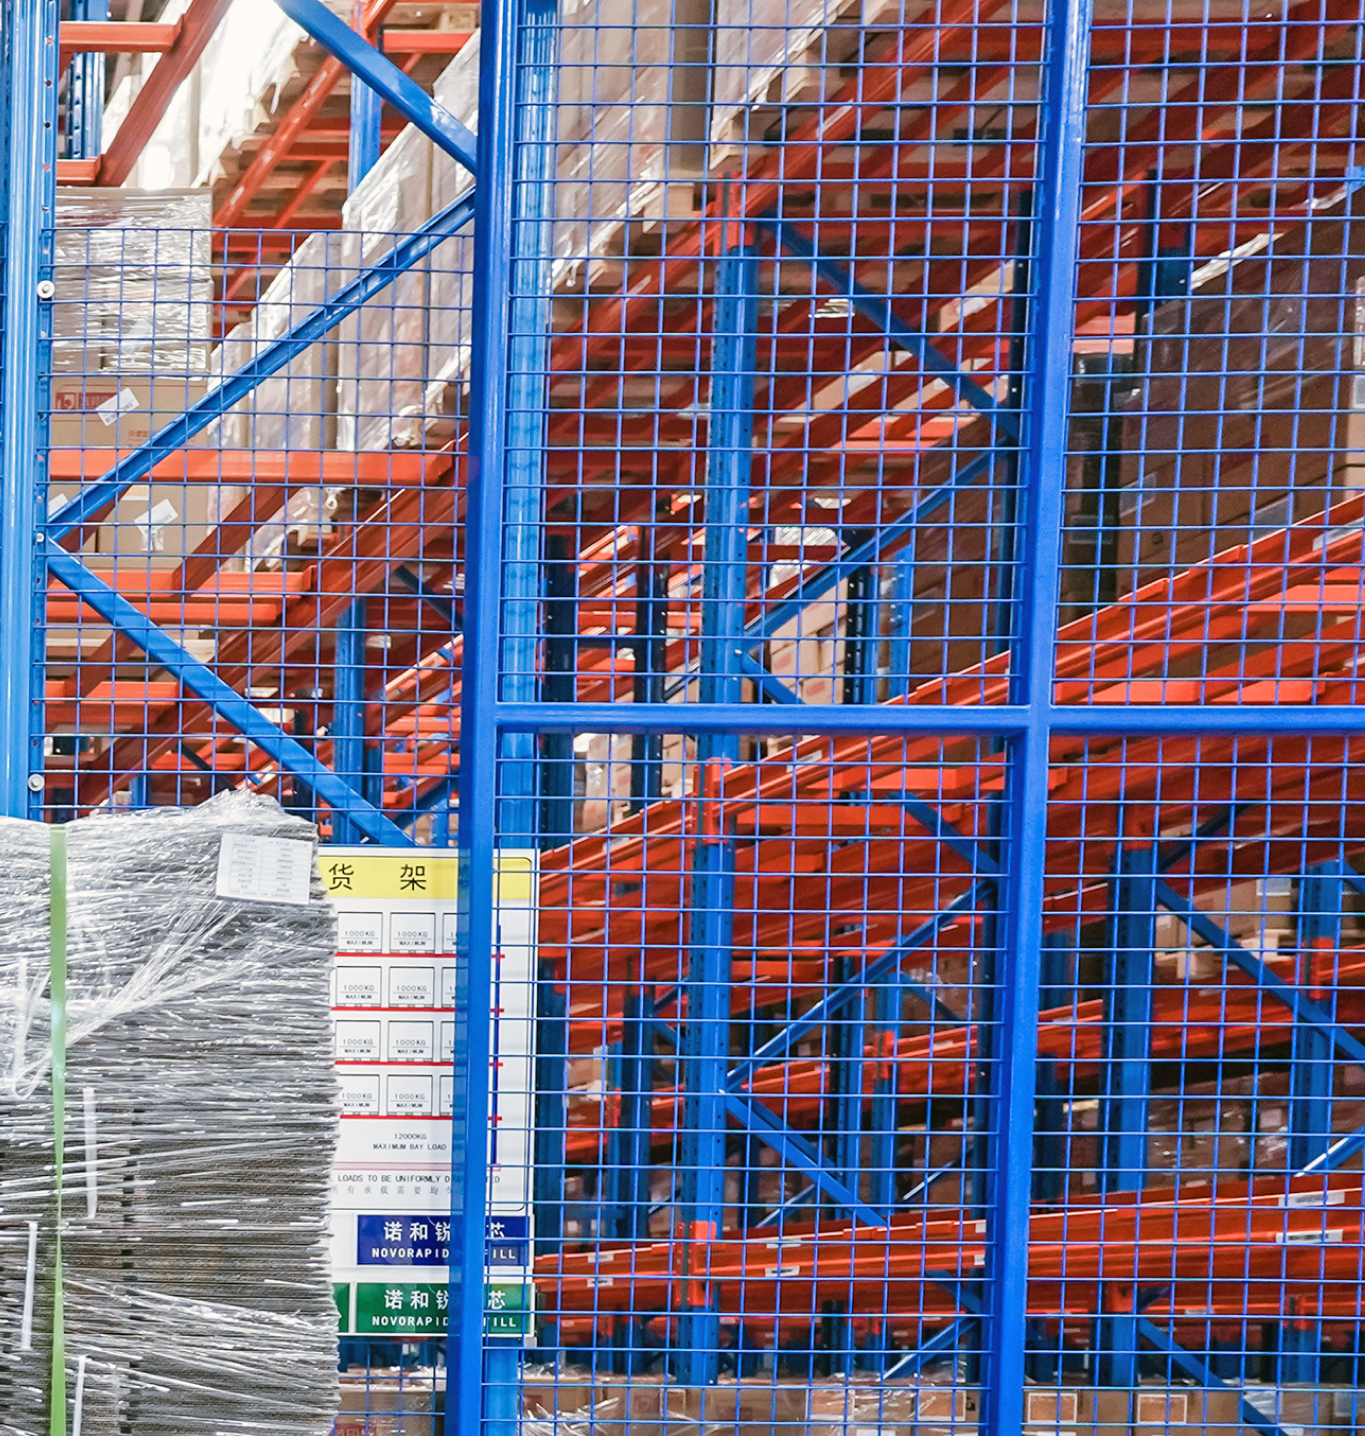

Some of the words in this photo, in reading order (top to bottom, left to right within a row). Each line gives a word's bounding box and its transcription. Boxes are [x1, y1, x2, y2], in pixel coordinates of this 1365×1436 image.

[328, 863, 427, 891] 货架
[427, 1143, 447, 1151] LOAD
[381, 1175, 392, 1183] BE
[395, 1175, 441, 1183] UNIFORMLY
[371, 1247, 450, 1259] NOVORAPID
[371, 1315, 449, 1327] NOVORAPID
